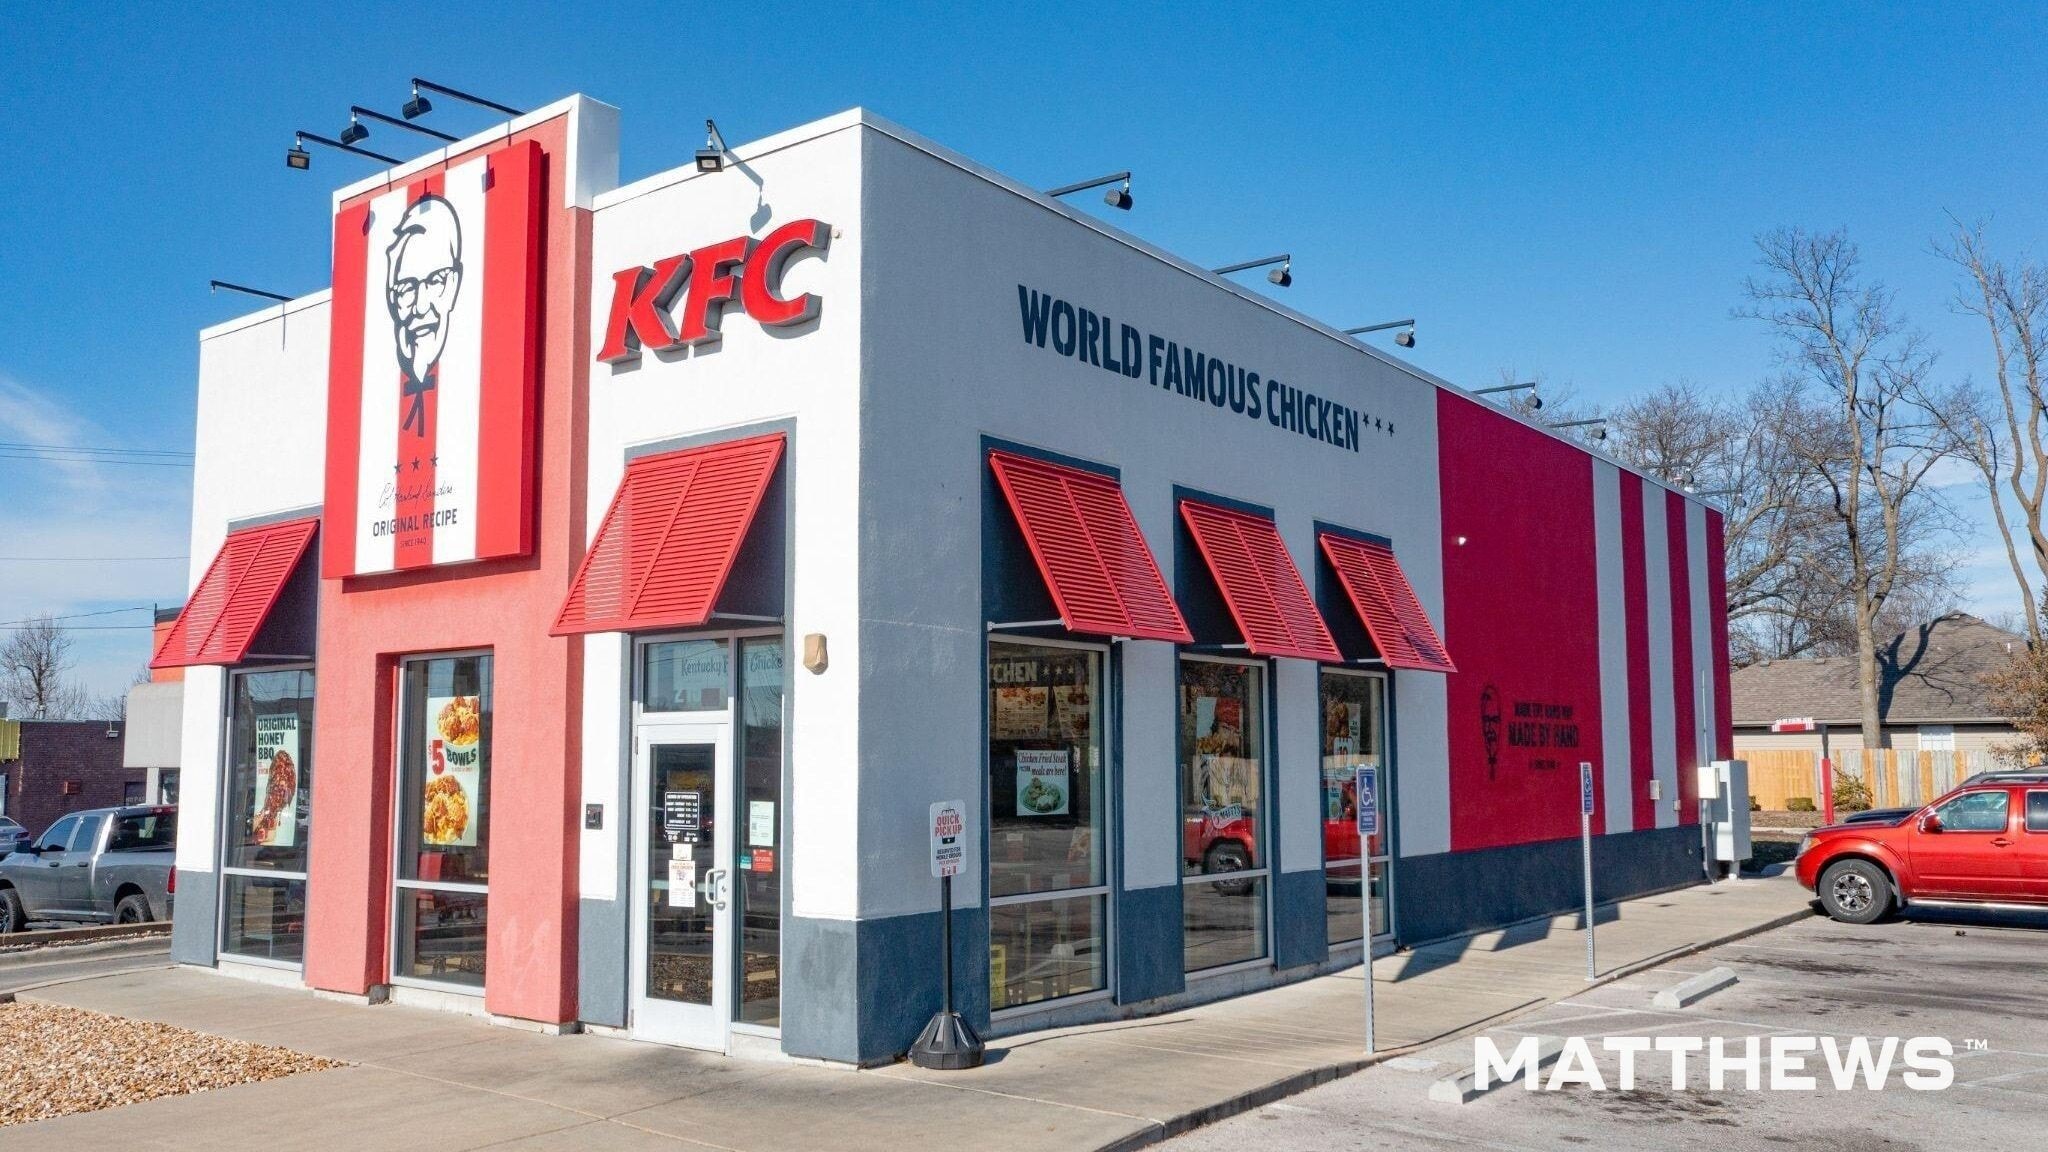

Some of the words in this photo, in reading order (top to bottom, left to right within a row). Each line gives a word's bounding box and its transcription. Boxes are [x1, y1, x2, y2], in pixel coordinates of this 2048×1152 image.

[597, 219, 831, 361] KFC
[1017, 284, 1142, 379] WORLD
[1149, 334, 1261, 419] FAMOUS
[1266, 379, 1359, 453] CHICKEN
[373, 515, 420, 537] ORIGINAL
[423, 508, 457, 529] RECIPE
[681, 656, 720, 677] Kentucky
[258, 717, 297, 731] ORIGINAL
[258, 731, 285, 746] HONEY
[258, 747, 274, 760] BBQ
[446, 748, 476, 766] BOWLS
[937, 814, 960, 826] QUICK
[935, 825, 951, 837] PICK
[952, 823, 962, 835] UP
